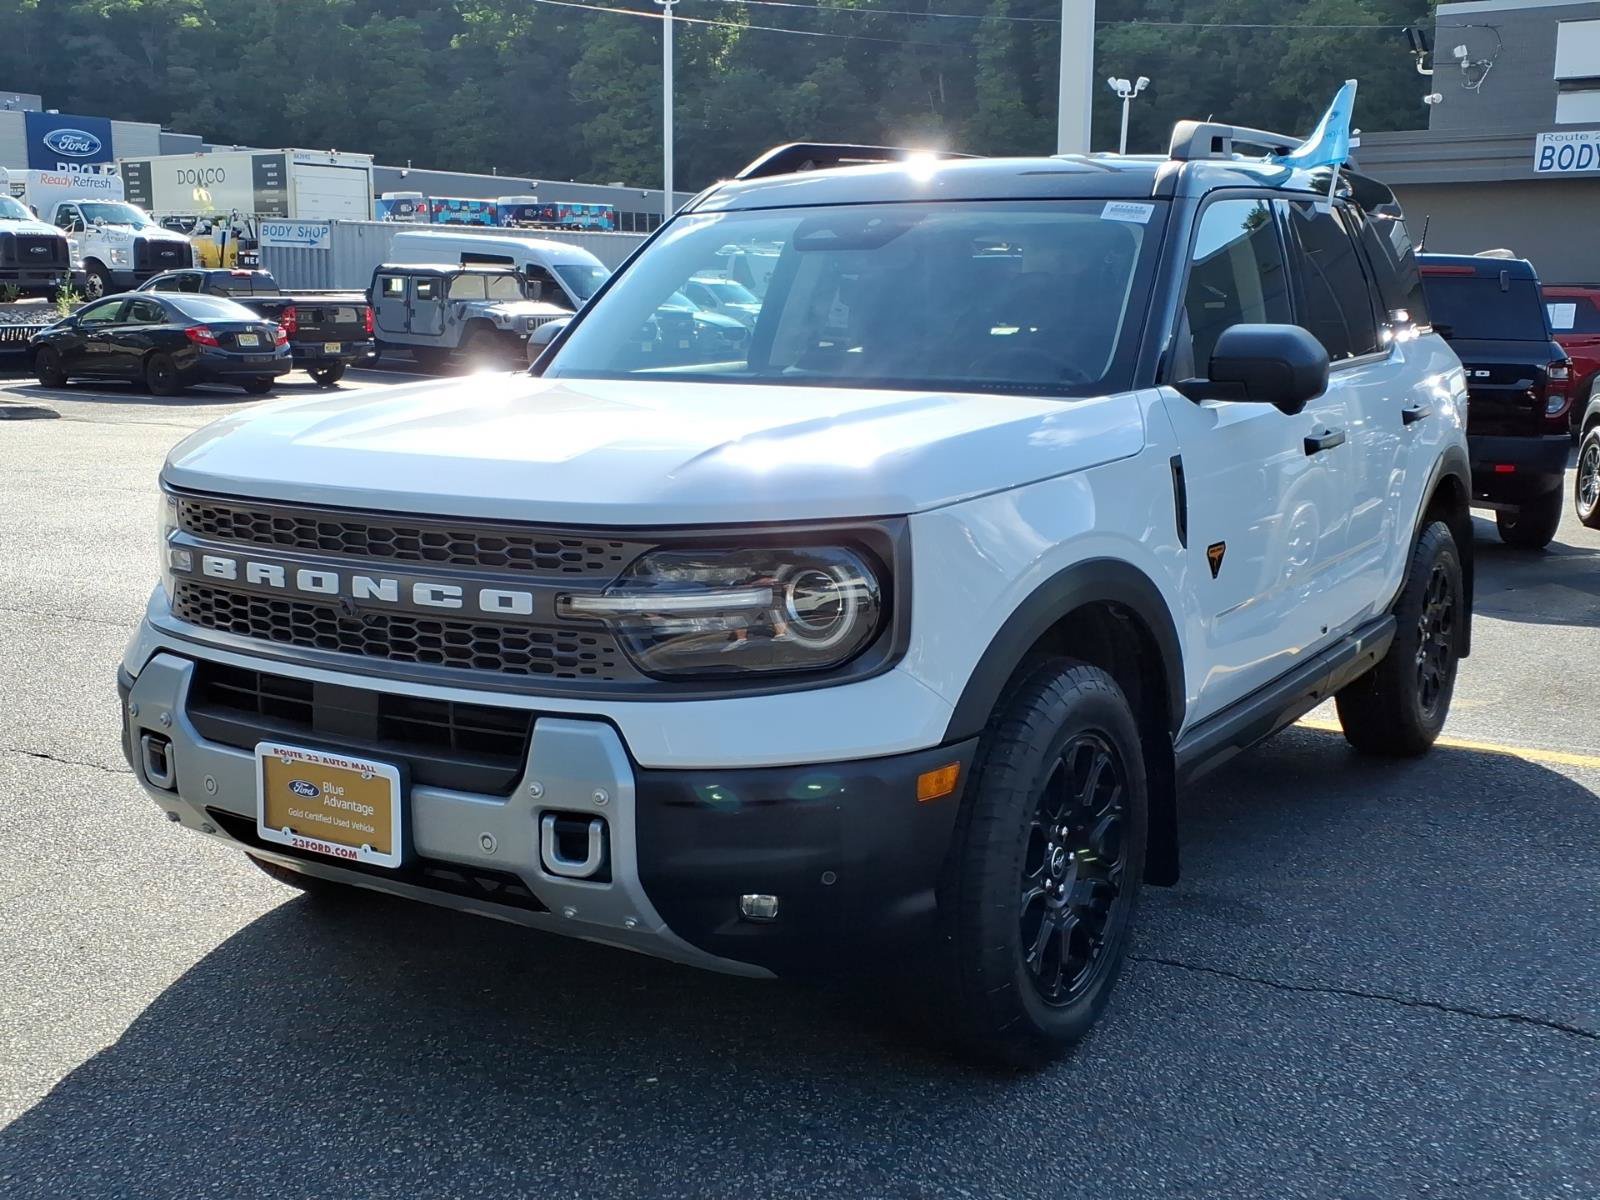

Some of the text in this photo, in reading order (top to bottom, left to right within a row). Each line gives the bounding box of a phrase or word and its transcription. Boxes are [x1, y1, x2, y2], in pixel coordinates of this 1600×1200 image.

[58, 134, 91, 152] Ford
[1543, 133, 1589, 142] Route
[40, 172, 111, 190] ReadyRefresh
[262, 224, 329, 239] BODY SHOP
[202, 554, 533, 616] BRONCO
[273, 748, 302, 759] ROUTE
[322, 757, 347, 767] AUTO
[351, 762, 376, 773] MALL
[293, 781, 344, 796] Ford Blue
[323, 794, 374, 816] Advantage
[288, 807, 375, 833] Gold Certified Used Vehicle
[292, 838, 357, 859] 23FORD.COM
